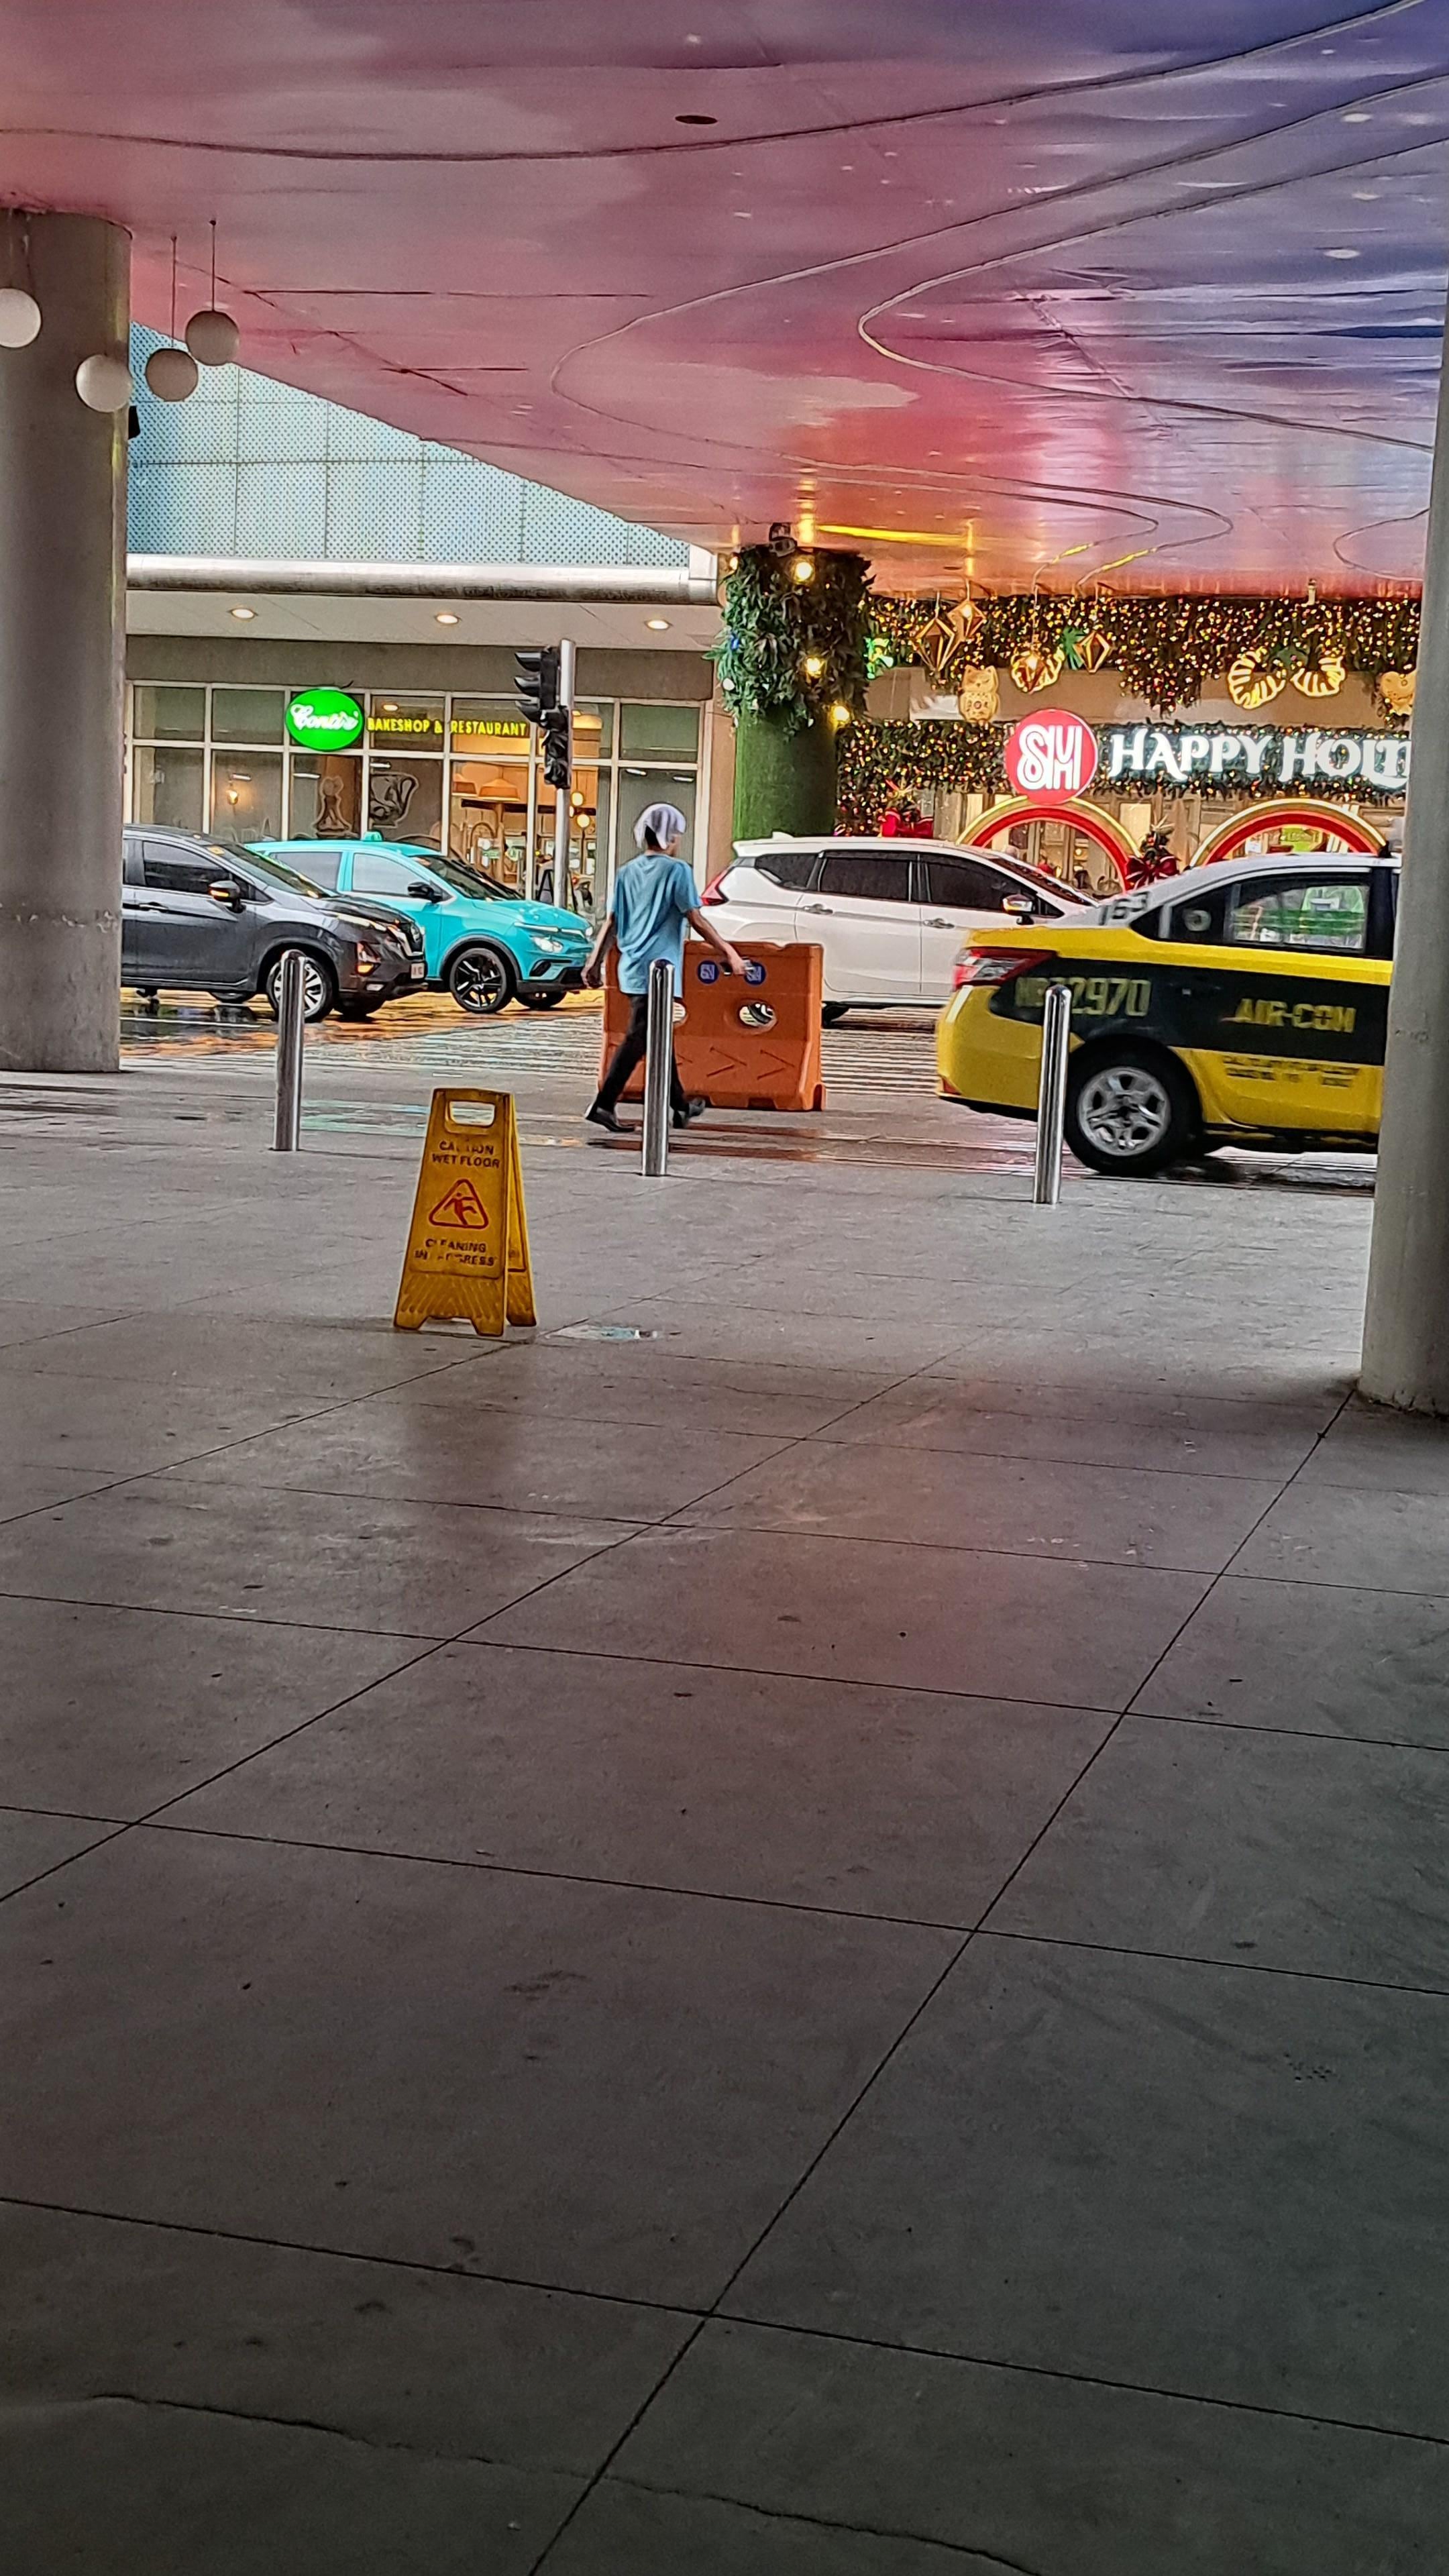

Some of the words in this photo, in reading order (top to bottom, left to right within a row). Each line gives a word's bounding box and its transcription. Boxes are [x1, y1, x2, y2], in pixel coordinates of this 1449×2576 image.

[367, 718, 430, 733] BAKESHOP
[450, 720, 527, 735] RESTAURANT
[1016, 724, 1083, 790] SM
[1108, 727, 1272, 782] HAPPY
[432, 1153, 457, 1165] WET
[460, 1156, 500, 1169] FLOOR
[425, 1238, 486, 1253] CEANING
